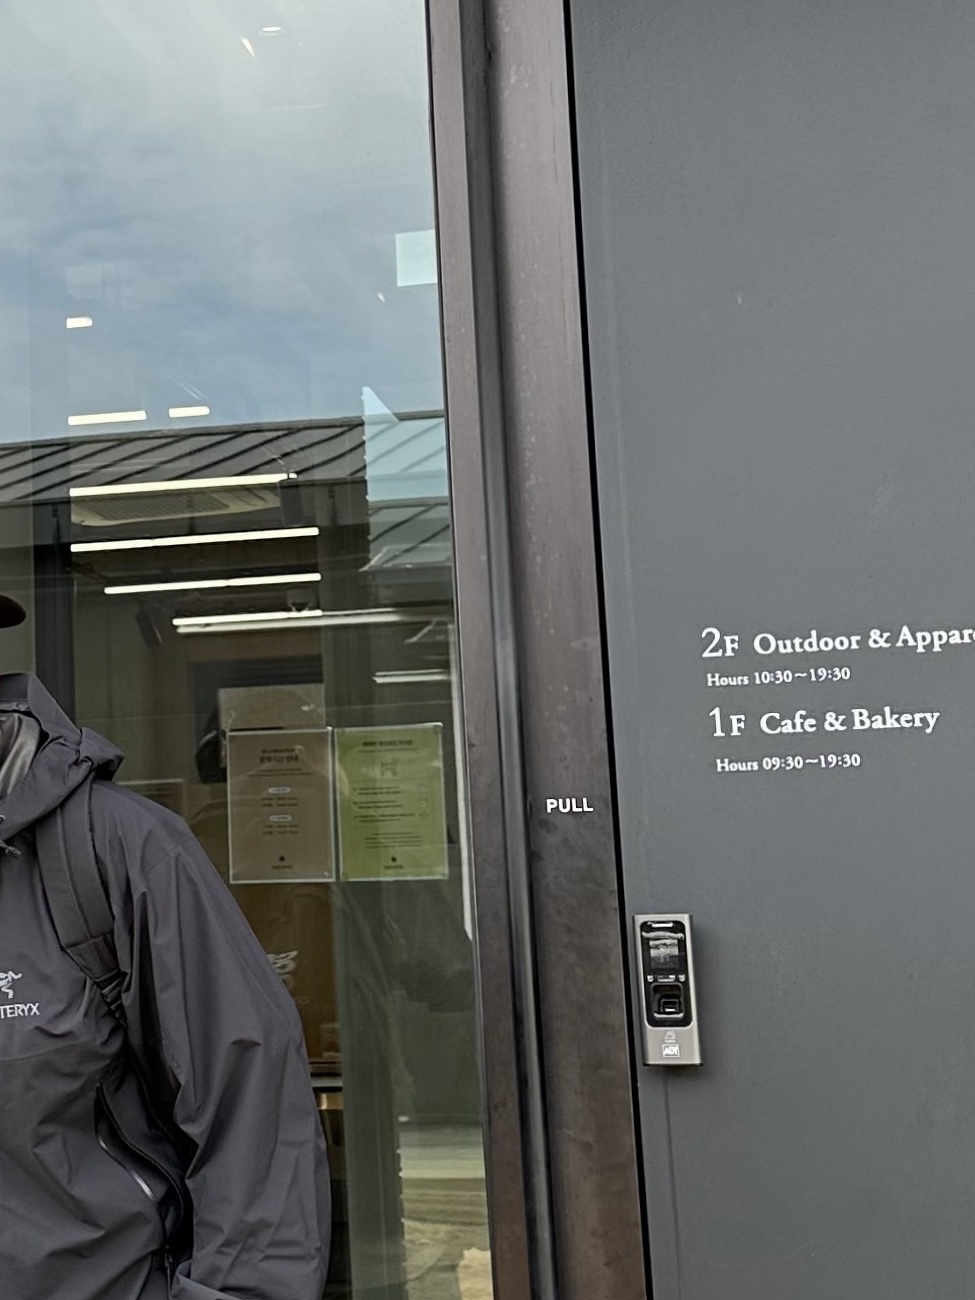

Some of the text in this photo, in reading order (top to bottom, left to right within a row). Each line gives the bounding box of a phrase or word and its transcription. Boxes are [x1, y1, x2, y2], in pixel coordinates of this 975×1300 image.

[701, 624, 975, 658] 2F Outdoor & Appar
[706, 673, 750, 687] Hours
[708, 706, 941, 737] 1F Cafe & Bakery
[716, 758, 759, 772] Hours
[546, 797, 594, 813] PULL
